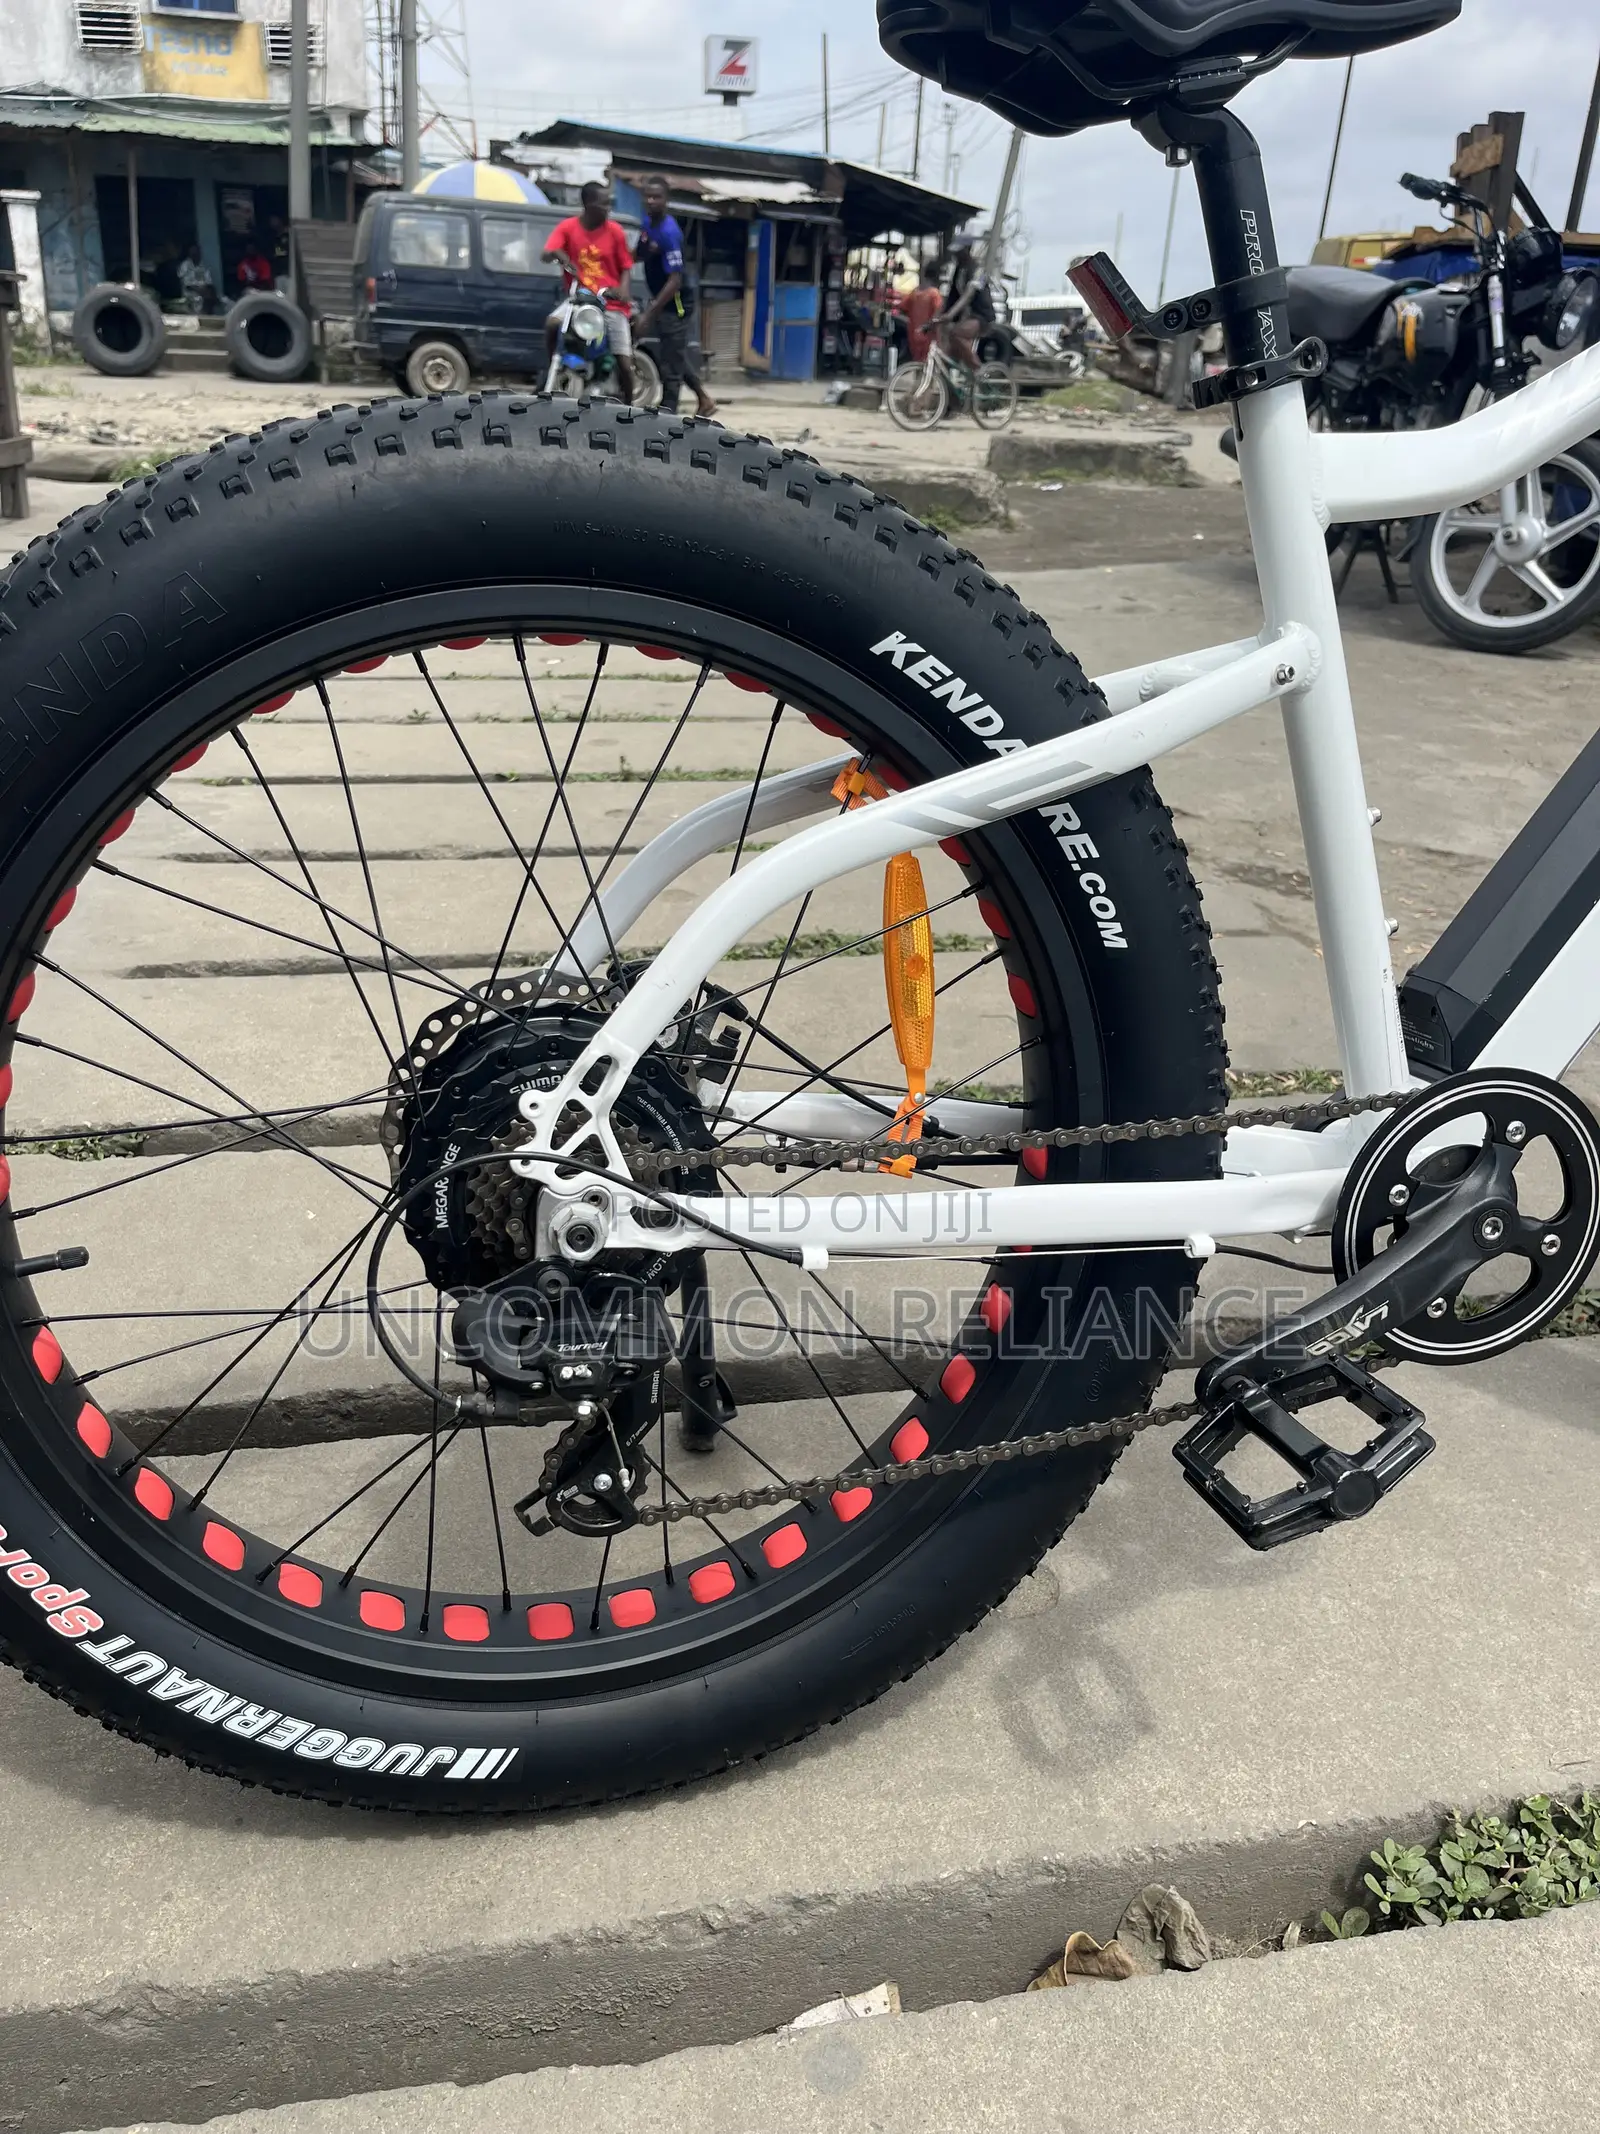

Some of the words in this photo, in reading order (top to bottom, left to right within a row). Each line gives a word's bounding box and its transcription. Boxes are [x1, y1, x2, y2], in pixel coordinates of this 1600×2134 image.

[1240, 209, 1278, 359] PROAX
[509, 1073, 567, 1095] SHIMA
[434, 1143, 461, 1229] MEGARNGE
[557, 1341, 608, 1352] Tourney
[650, 1370, 660, 1404] SHIMAN
[0, 1524, 104, 1638] Spor
[75, 1634, 459, 1777] JUGGERNAUT
